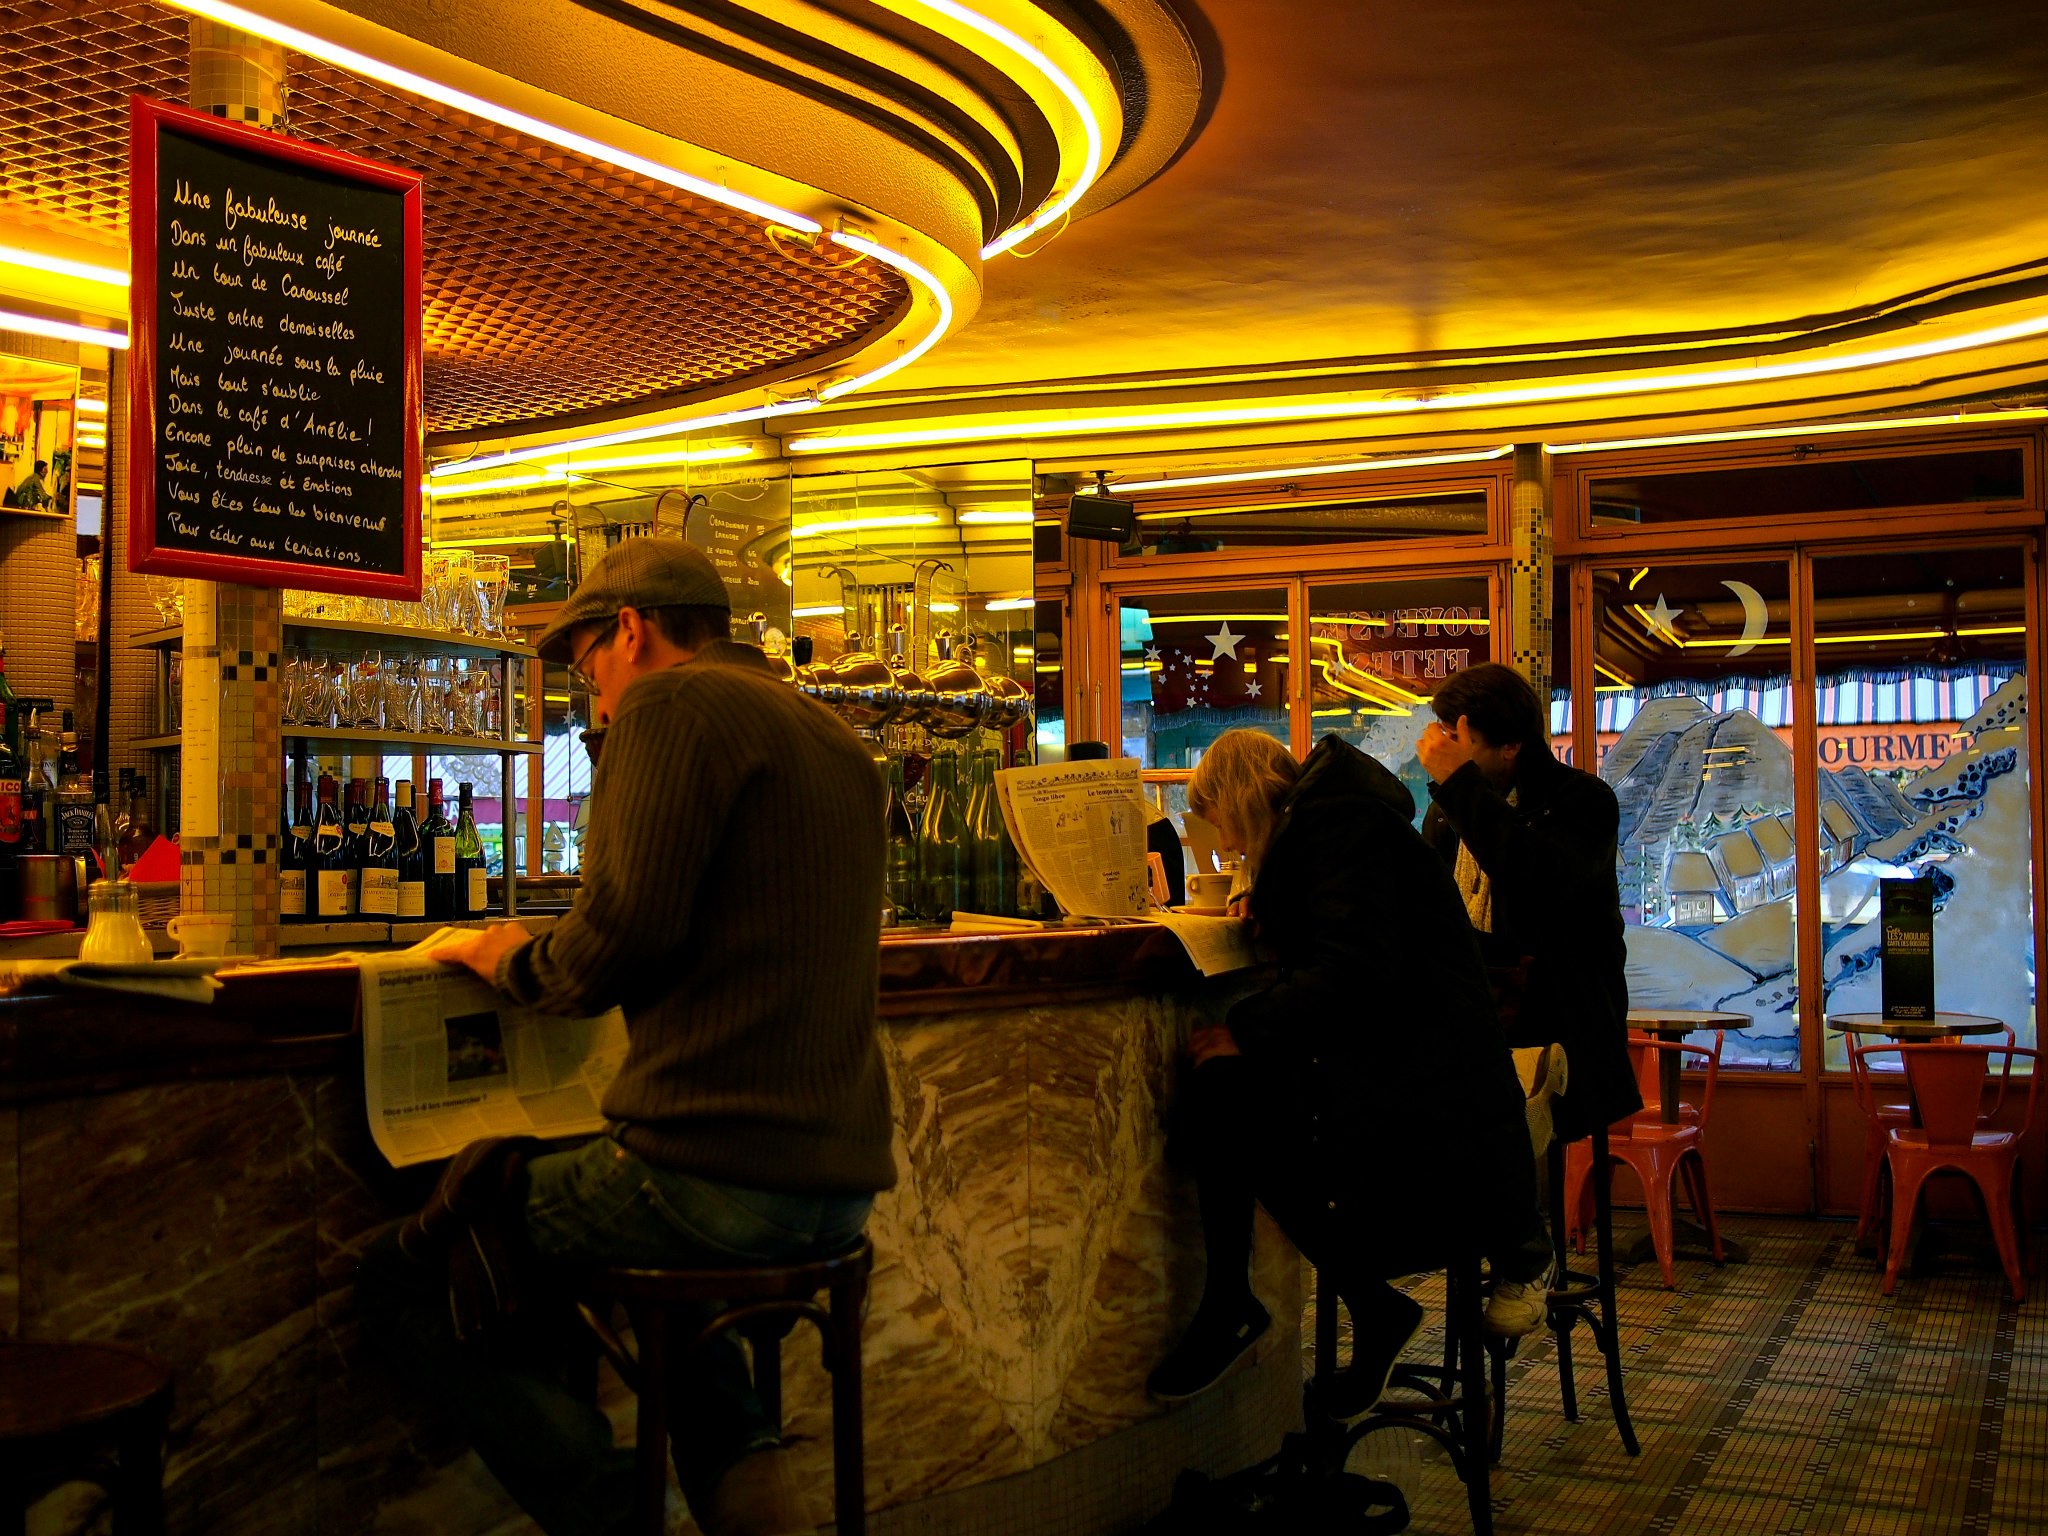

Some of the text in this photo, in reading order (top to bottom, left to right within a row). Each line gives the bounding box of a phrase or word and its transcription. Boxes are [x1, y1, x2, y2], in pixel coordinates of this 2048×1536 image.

[174, 179, 382, 249] Une fabuleuse journée
[171, 220, 345, 280] Dans un fabuleux café
[172, 260, 200, 280] Un
[214, 262, 243, 287] tour
[252, 273, 267, 291] de
[170, 291, 355, 339] Juste entre demoiselles
[169, 332, 384, 386] Une journée sous la pluie
[171, 365, 320, 401] Mais tout s'oublie
[169, 394, 203, 414] Dans
[239, 406, 268, 431] café
[165, 422, 211, 446] Encore
[227, 434, 262, 460] plein
[272, 445, 287, 462] de
[296, 453, 355, 472] surprises
[217, 460, 272, 485] tendresse
[303, 477, 352, 496] émotions
[169, 481, 199, 503] Vous
[212, 490, 243, 511] êtes
[253, 497, 281, 515] tous
[289, 502, 306, 517] les
[168, 512, 199, 536] Pour
[210, 525, 243, 544] céder
[250, 538, 274, 550] aux
[1818, 733, 1975, 764] OURMET
